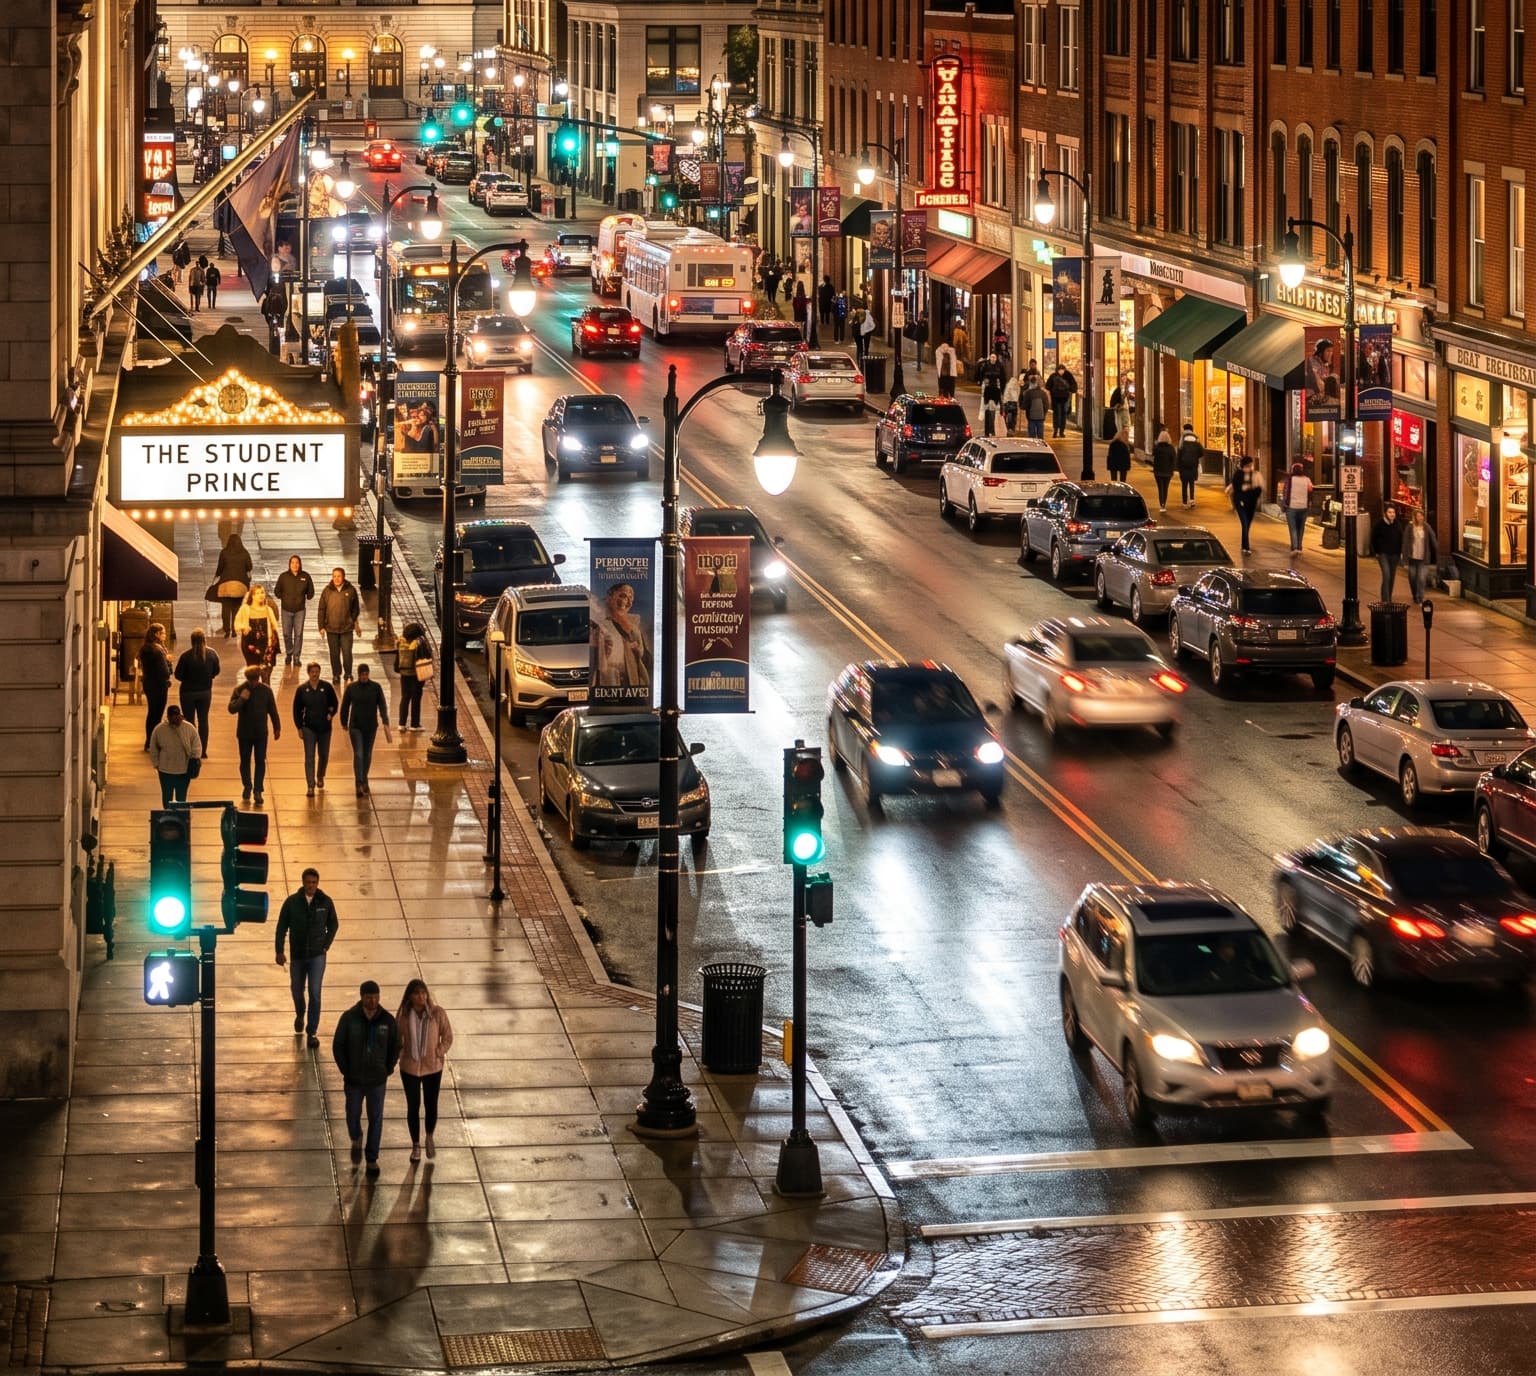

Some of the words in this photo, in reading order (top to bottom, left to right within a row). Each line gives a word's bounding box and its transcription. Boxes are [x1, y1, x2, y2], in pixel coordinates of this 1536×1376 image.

[142, 444, 190, 464] THE
[205, 442, 324, 463] STUDENT
[187, 472, 281, 492] PRINCE
